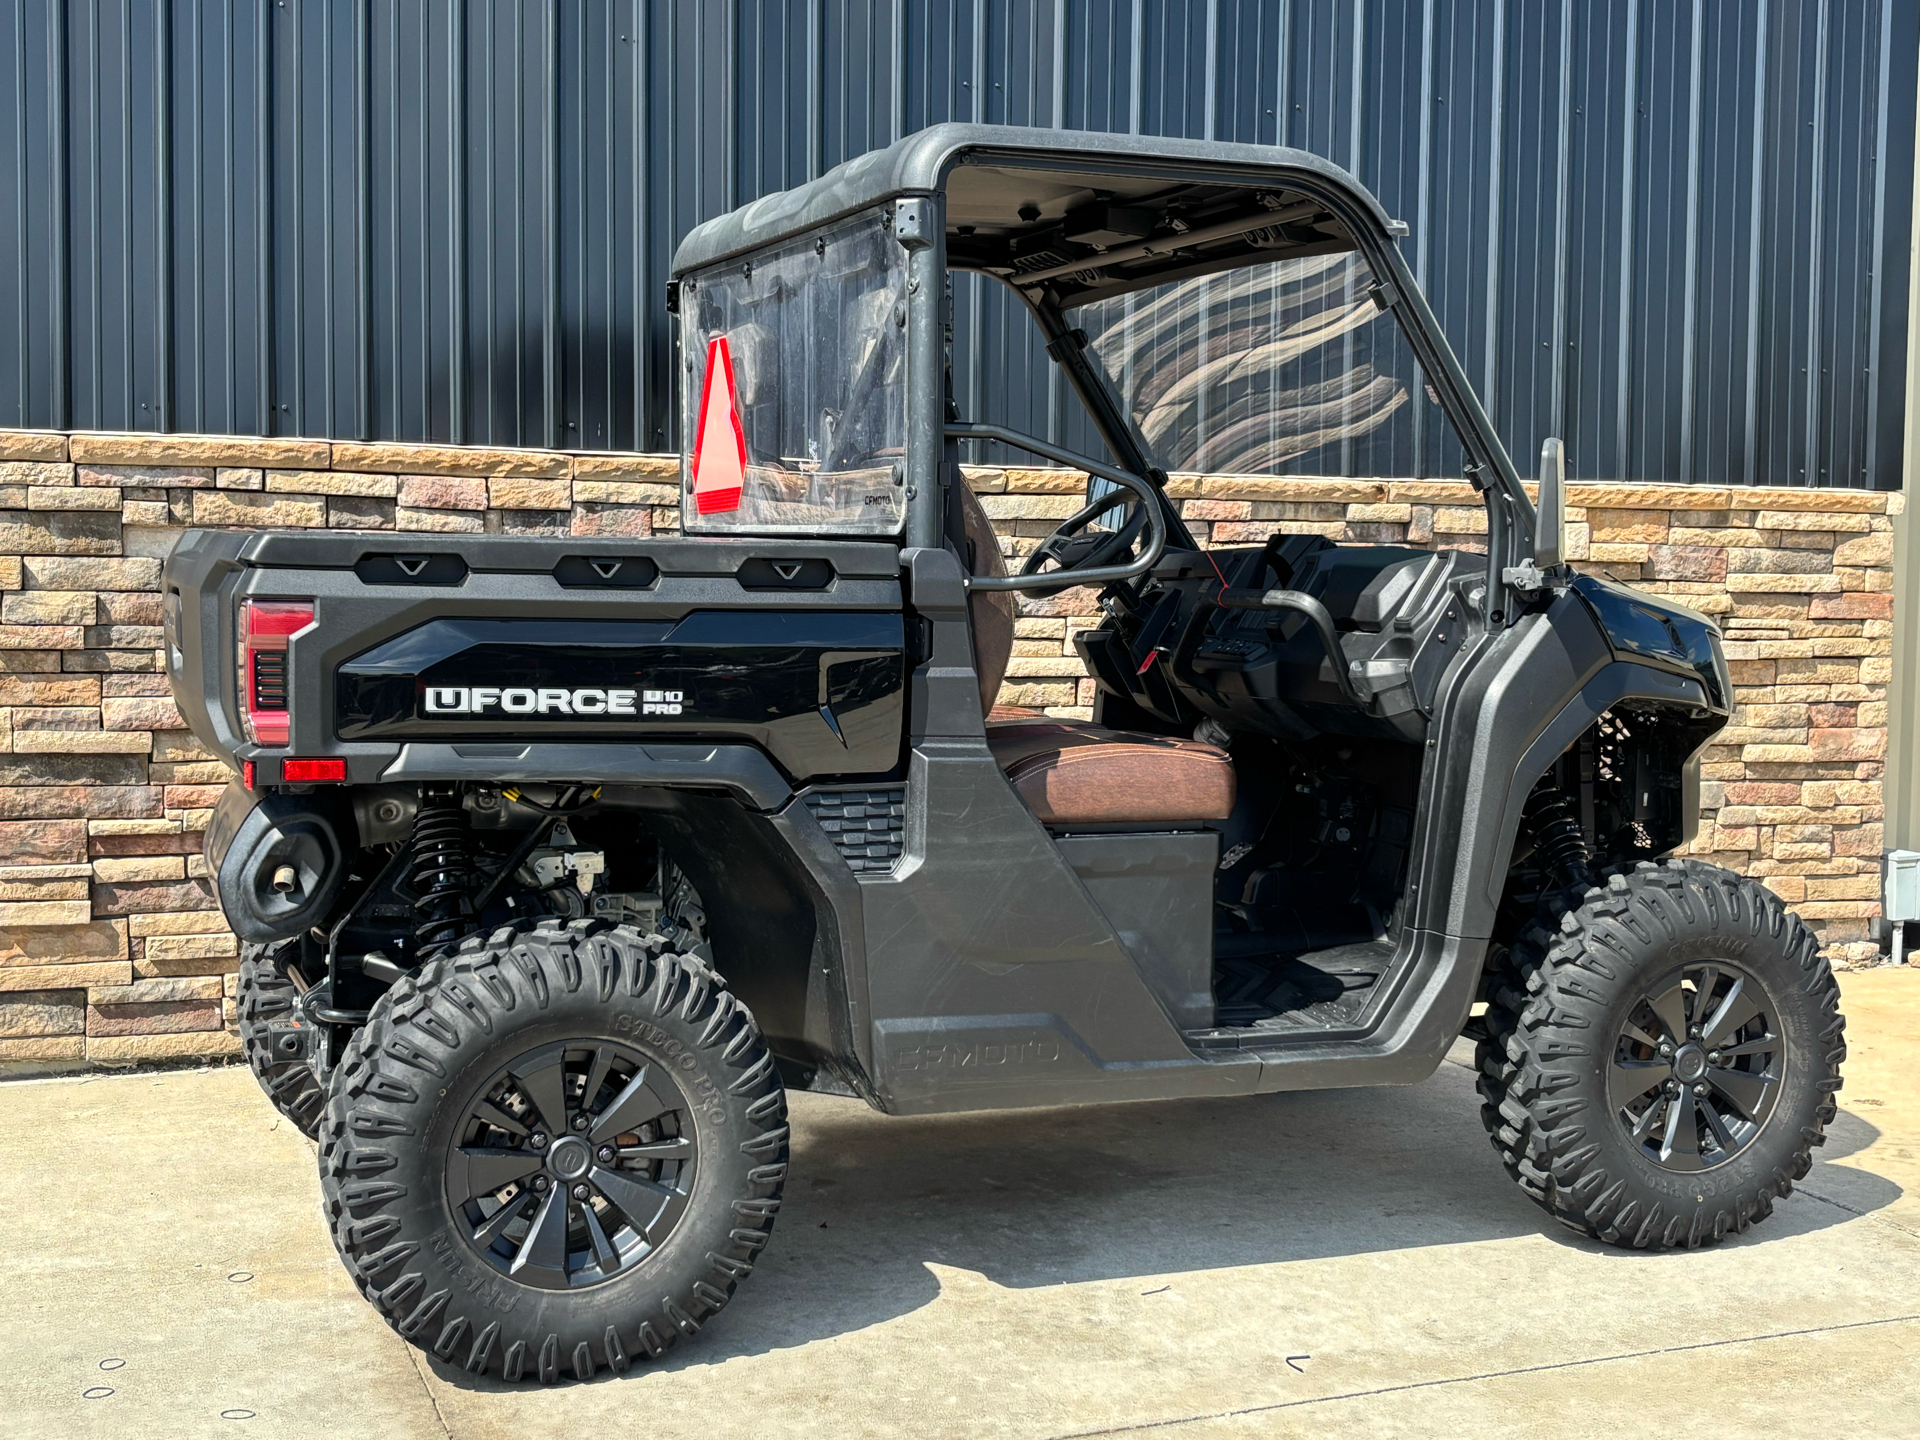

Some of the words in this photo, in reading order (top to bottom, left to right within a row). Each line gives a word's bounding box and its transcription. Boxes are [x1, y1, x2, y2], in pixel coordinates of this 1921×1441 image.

[864, 495, 891, 506] CFMOTO
[425, 687, 637, 714] UFORCE
[643, 704, 683, 715] PRO
[615, 1013, 699, 1072] STEGO
